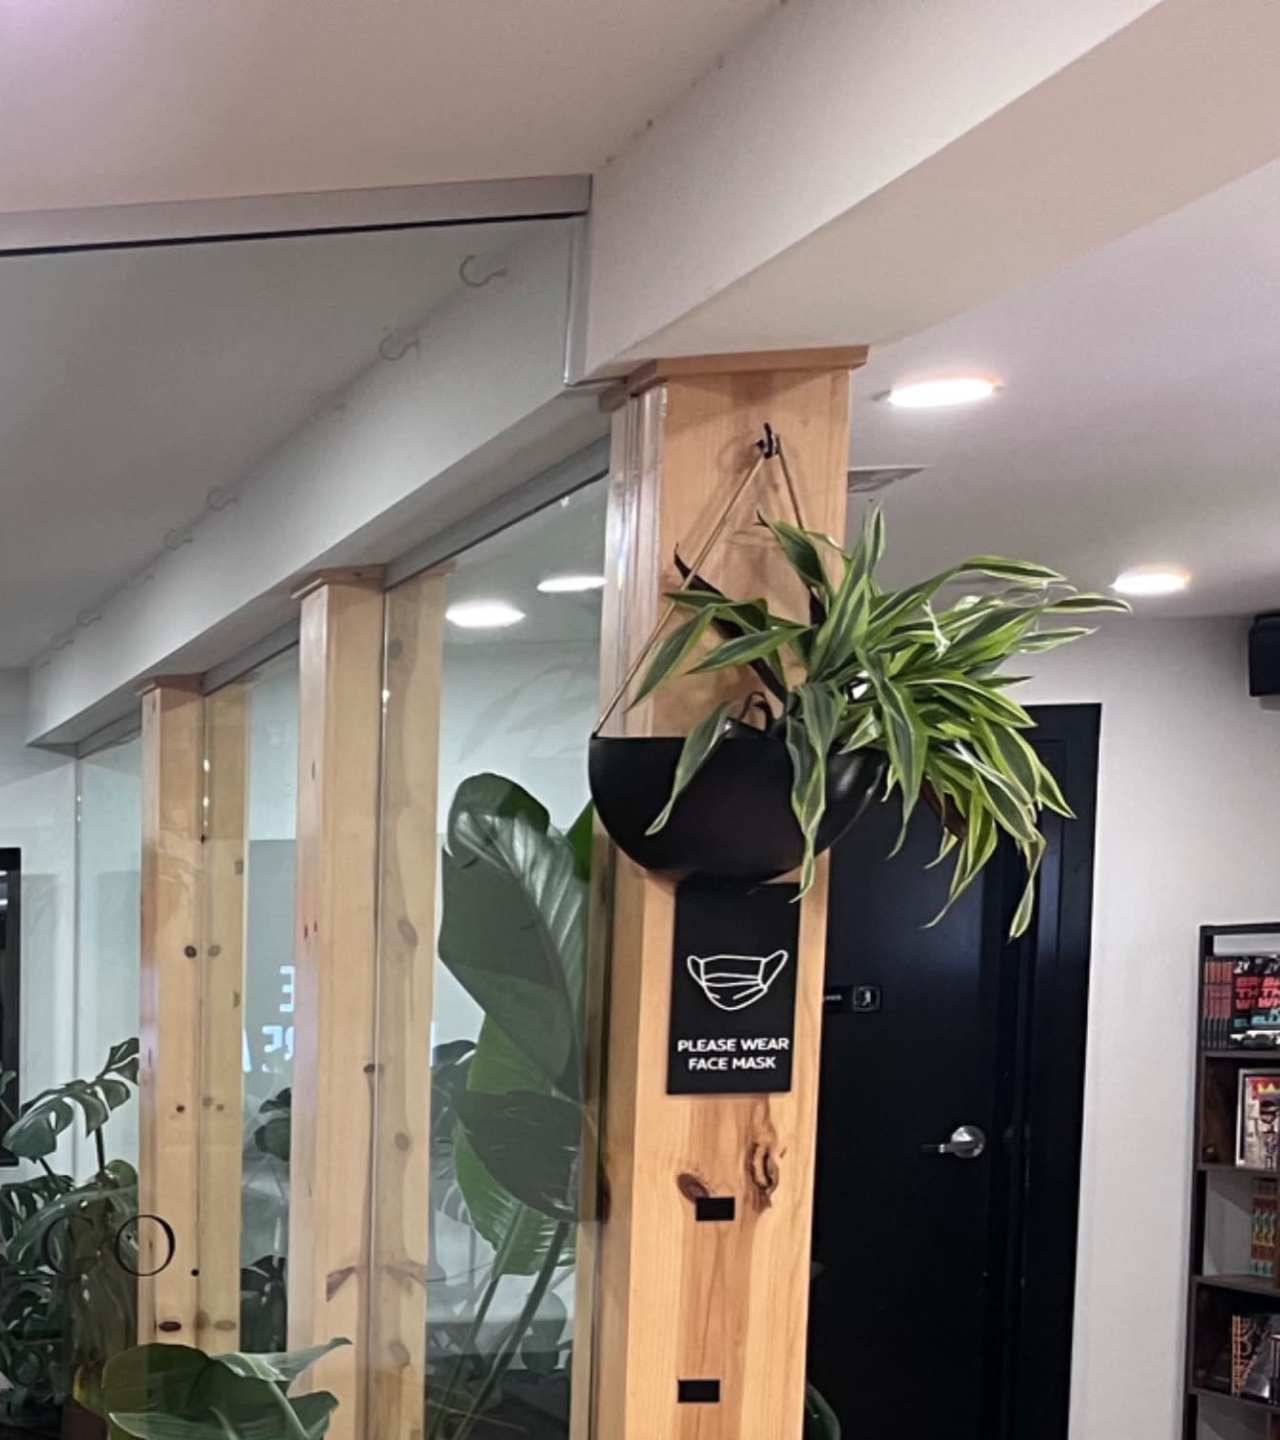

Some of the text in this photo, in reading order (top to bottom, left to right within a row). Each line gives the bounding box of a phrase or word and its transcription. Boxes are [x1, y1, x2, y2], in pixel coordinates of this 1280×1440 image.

[677, 1037, 790, 1052] PLEASE WEAR
[688, 1056, 776, 1071] FACE MASK
